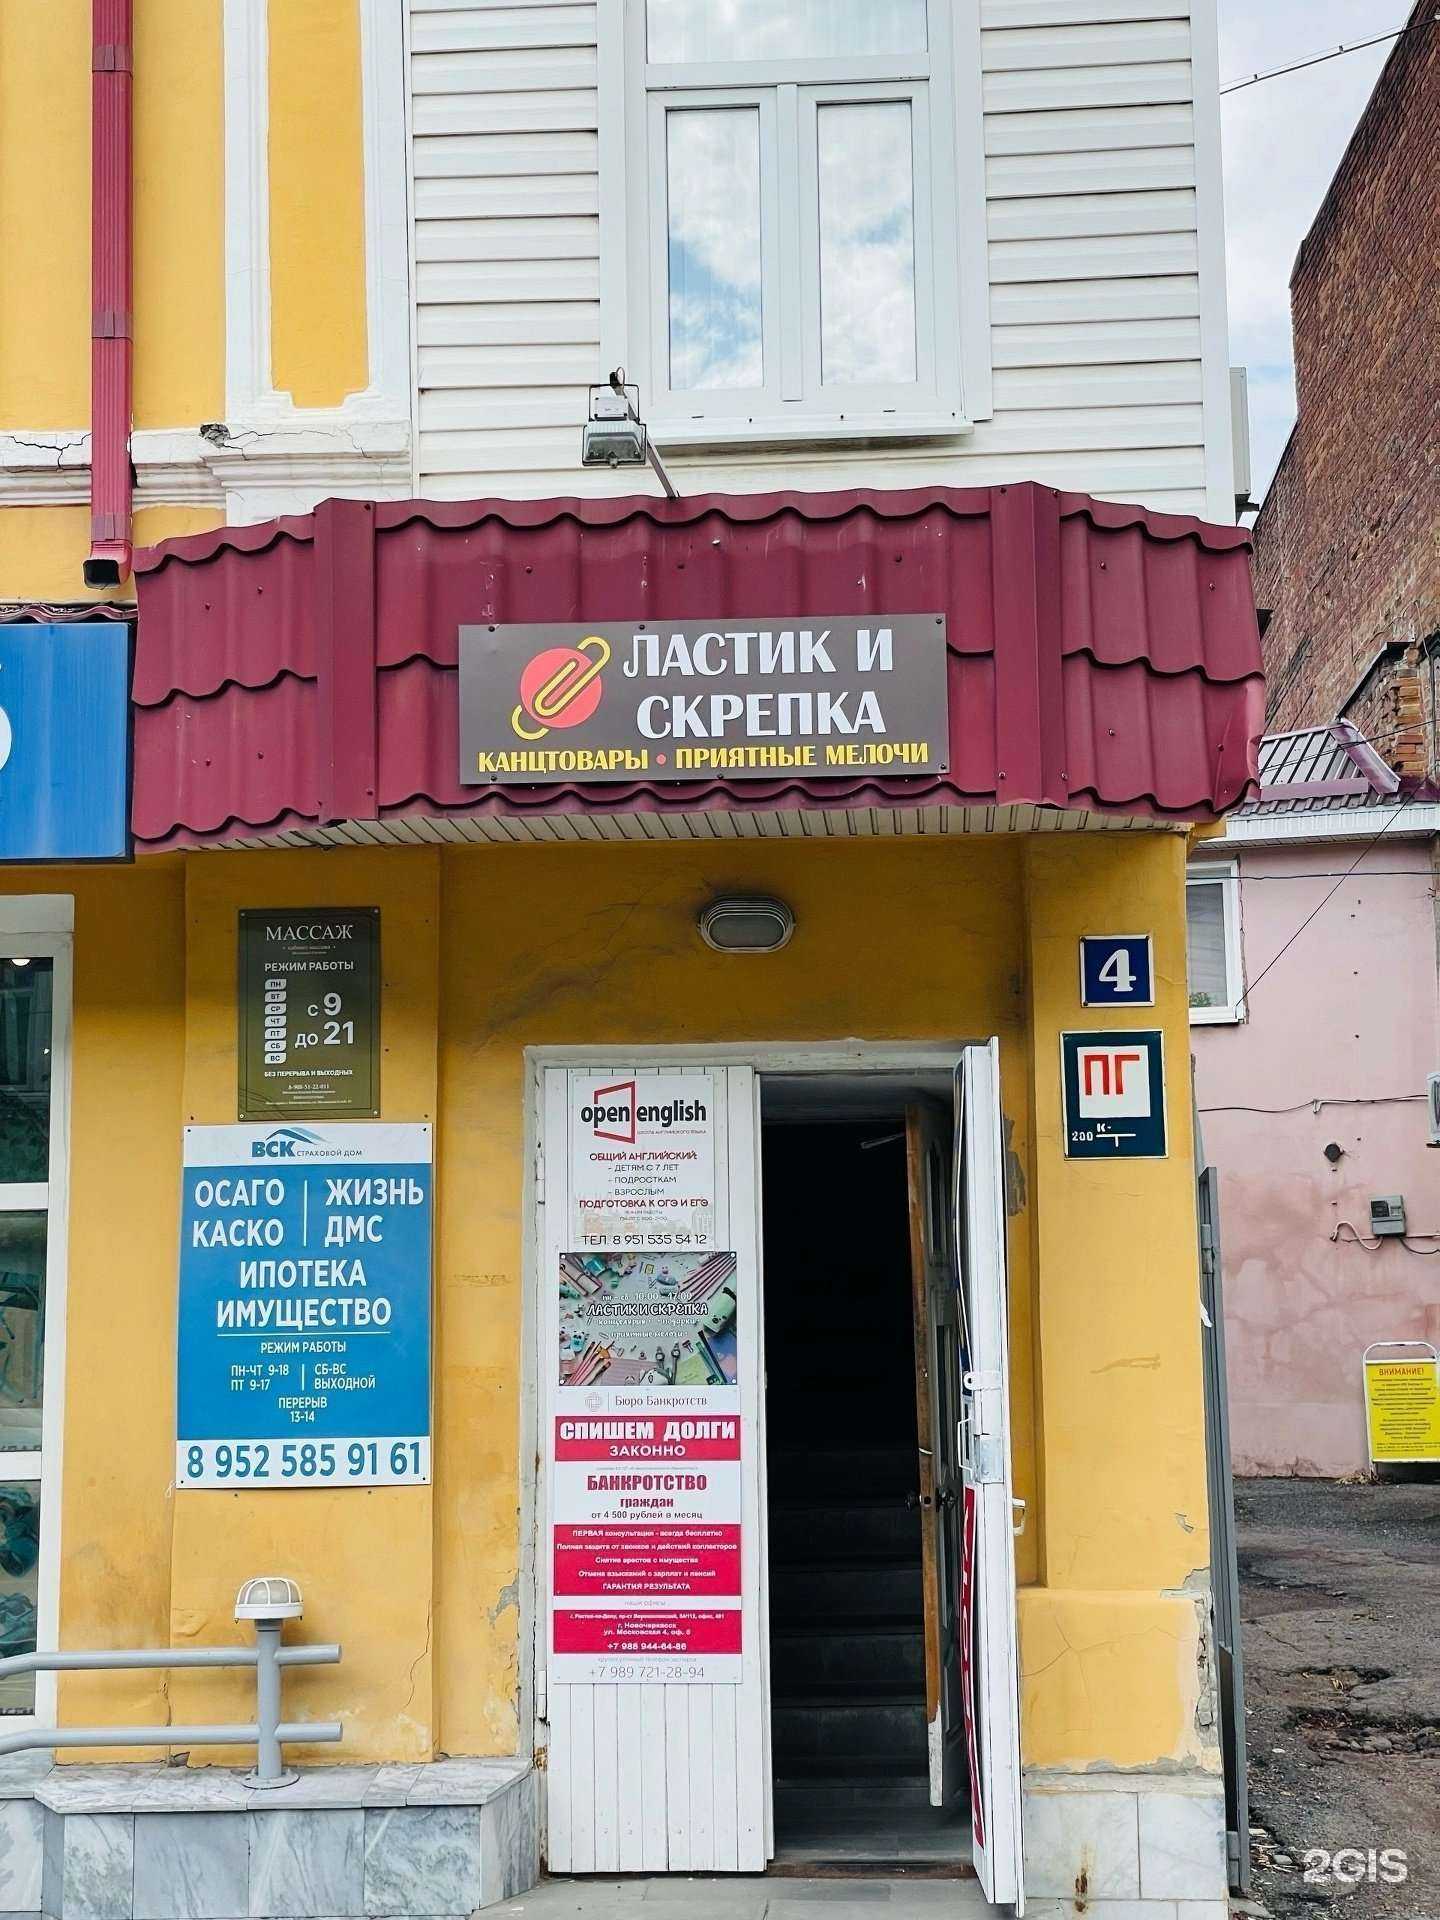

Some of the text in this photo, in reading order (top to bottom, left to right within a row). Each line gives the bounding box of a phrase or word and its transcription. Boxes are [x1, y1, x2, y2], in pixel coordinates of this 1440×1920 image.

[623, 629, 893, 677] ЛАСТИК И
[636, 691, 887, 739] СКРЕПКА
[478, 743, 929, 774] КАНЦТОВАРЫ ПРИЯТНЫЕ МЕЛОЧИ
[265, 925, 354, 941] МАССАЖ
[264, 961, 354, 972] РЕЖИМ РАБОТЫ
[1099, 949, 1137, 992] 4
[323, 992, 342, 1016] 9
[323, 1021, 354, 1045] 21
[1084, 1054, 1140, 1096] ПГ
[581, 1099, 707, 1128] open english
[1072, 1131, 1093, 1142] 200
[251, 1141, 296, 1158] ВСК
[296, 1149, 362, 1158] СТРАХОВОЙ ДОМ
[590, 1151, 627, 1162] ОБЩИЙ
[614, 1164, 645, 1172] ДЕТЯМ
[662, 1164, 679, 1172] ЛЕТ
[614, 1176, 677, 1184] ПОДРОСТКАМ
[195, 1178, 424, 1208] ОСАГО ЖИЗНЬ
[614, 1188, 665, 1196] ВЗРОСЛЫМ
[579, 1200, 646, 1209] ПОДГОТОВКА
[690, 1199, 709, 1207] ЕГЭ
[193, 1215, 383, 1248] КАСКО ДМС
[613, 1235, 621, 1245] 8
[624, 1235, 644, 1245] 951
[648, 1234, 672, 1245] 535
[676, 1234, 691, 1244] 54
[695, 1234, 707, 1244] 12
[240, 1259, 367, 1289] ИПОТЕКА
[217, 1297, 391, 1331] ИМУЩЕСТВО
[586, 1302, 709, 1316] ЛАСТИК И СКРЕПКА
[261, 1341, 346, 1354] РЕЖИМ РАБОТЫ
[231, 1364, 289, 1377] ПН-ЧТ 9-18
[314, 1363, 346, 1375] СБ-ВС
[1379, 1367, 1424, 1376] ВНИМАНИЕ!
[231, 1379, 270, 1391] ПТ 9-17
[314, 1374, 376, 1390] ВЫХОДНОЙ
[279, 1397, 328, 1409] ПЕРЕРЫВ
[615, 1394, 708, 1407] Бюро Банкротств
[290, 1411, 315, 1423] 13-14
[560, 1421, 736, 1441] СПИШЕМ ДОЛГИ
[610, 1445, 686, 1457] ЗАКОННО
[187, 1441, 420, 1479] 8 952 585 91 61
[587, 1474, 708, 1491] БАНКРОТСТВО
[620, 1498, 674, 1508] граждан
[630, 1511, 663, 1520] рублей
[610, 1666, 634, 1678] 989
[640, 1666, 704, 1679] 721-28-94
